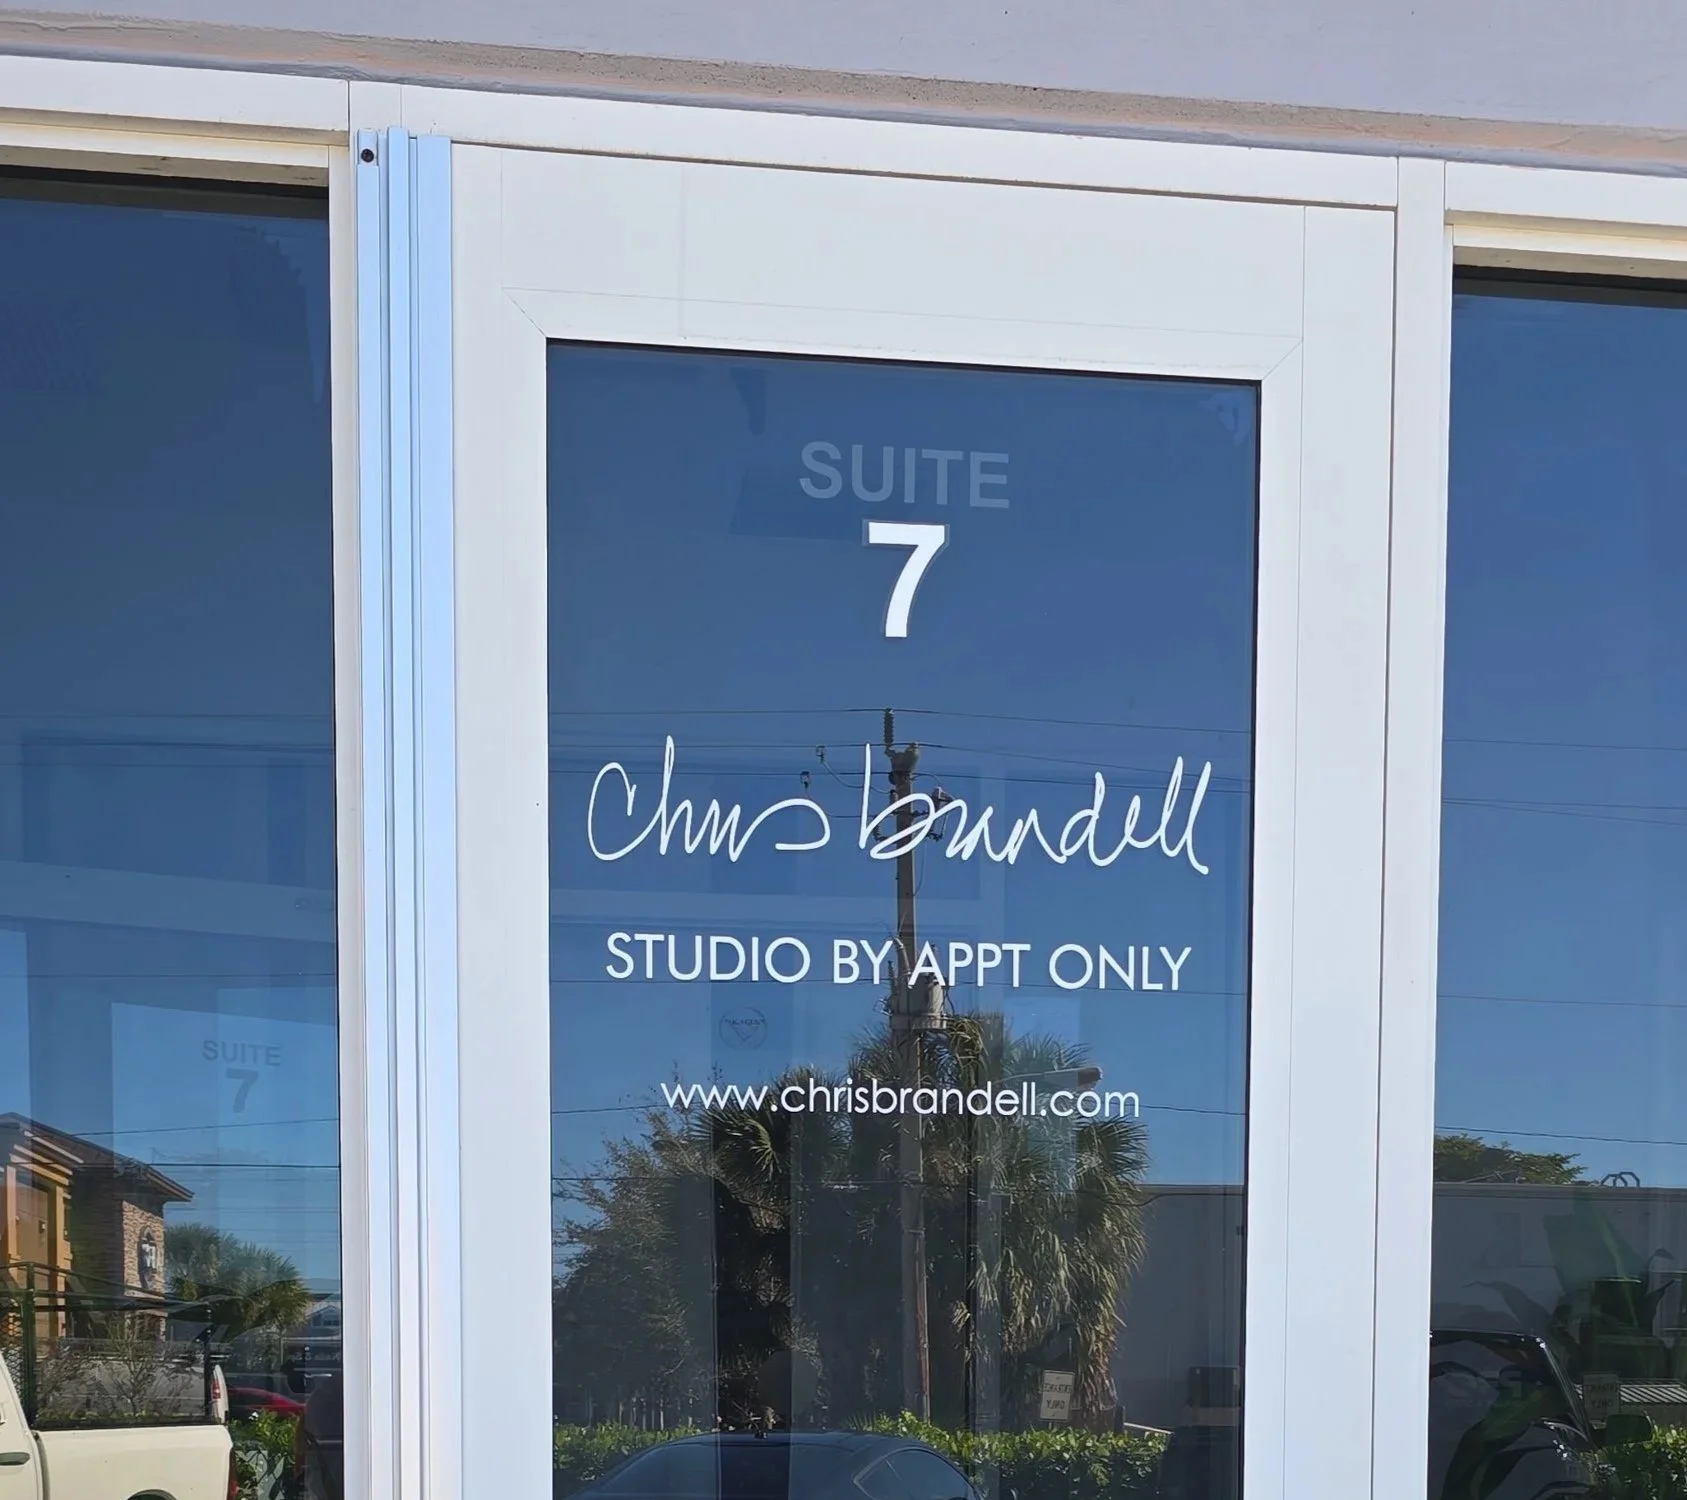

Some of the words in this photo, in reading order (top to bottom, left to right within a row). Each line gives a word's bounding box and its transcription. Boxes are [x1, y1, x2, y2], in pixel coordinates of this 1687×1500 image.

[799, 440, 1010, 509] SUITE
[865, 520, 947, 638] 7
[605, 931, 812, 984] STUDIO
[832, 938, 894, 986] BY
[907, 940, 1032, 989] APPT
[1048, 943, 1193, 992] ONLY
[202, 1039, 282, 1067] SUITE
[225, 1067, 259, 1113] 7
[659, 1076, 1140, 1119] www.chrisbrandell.com
